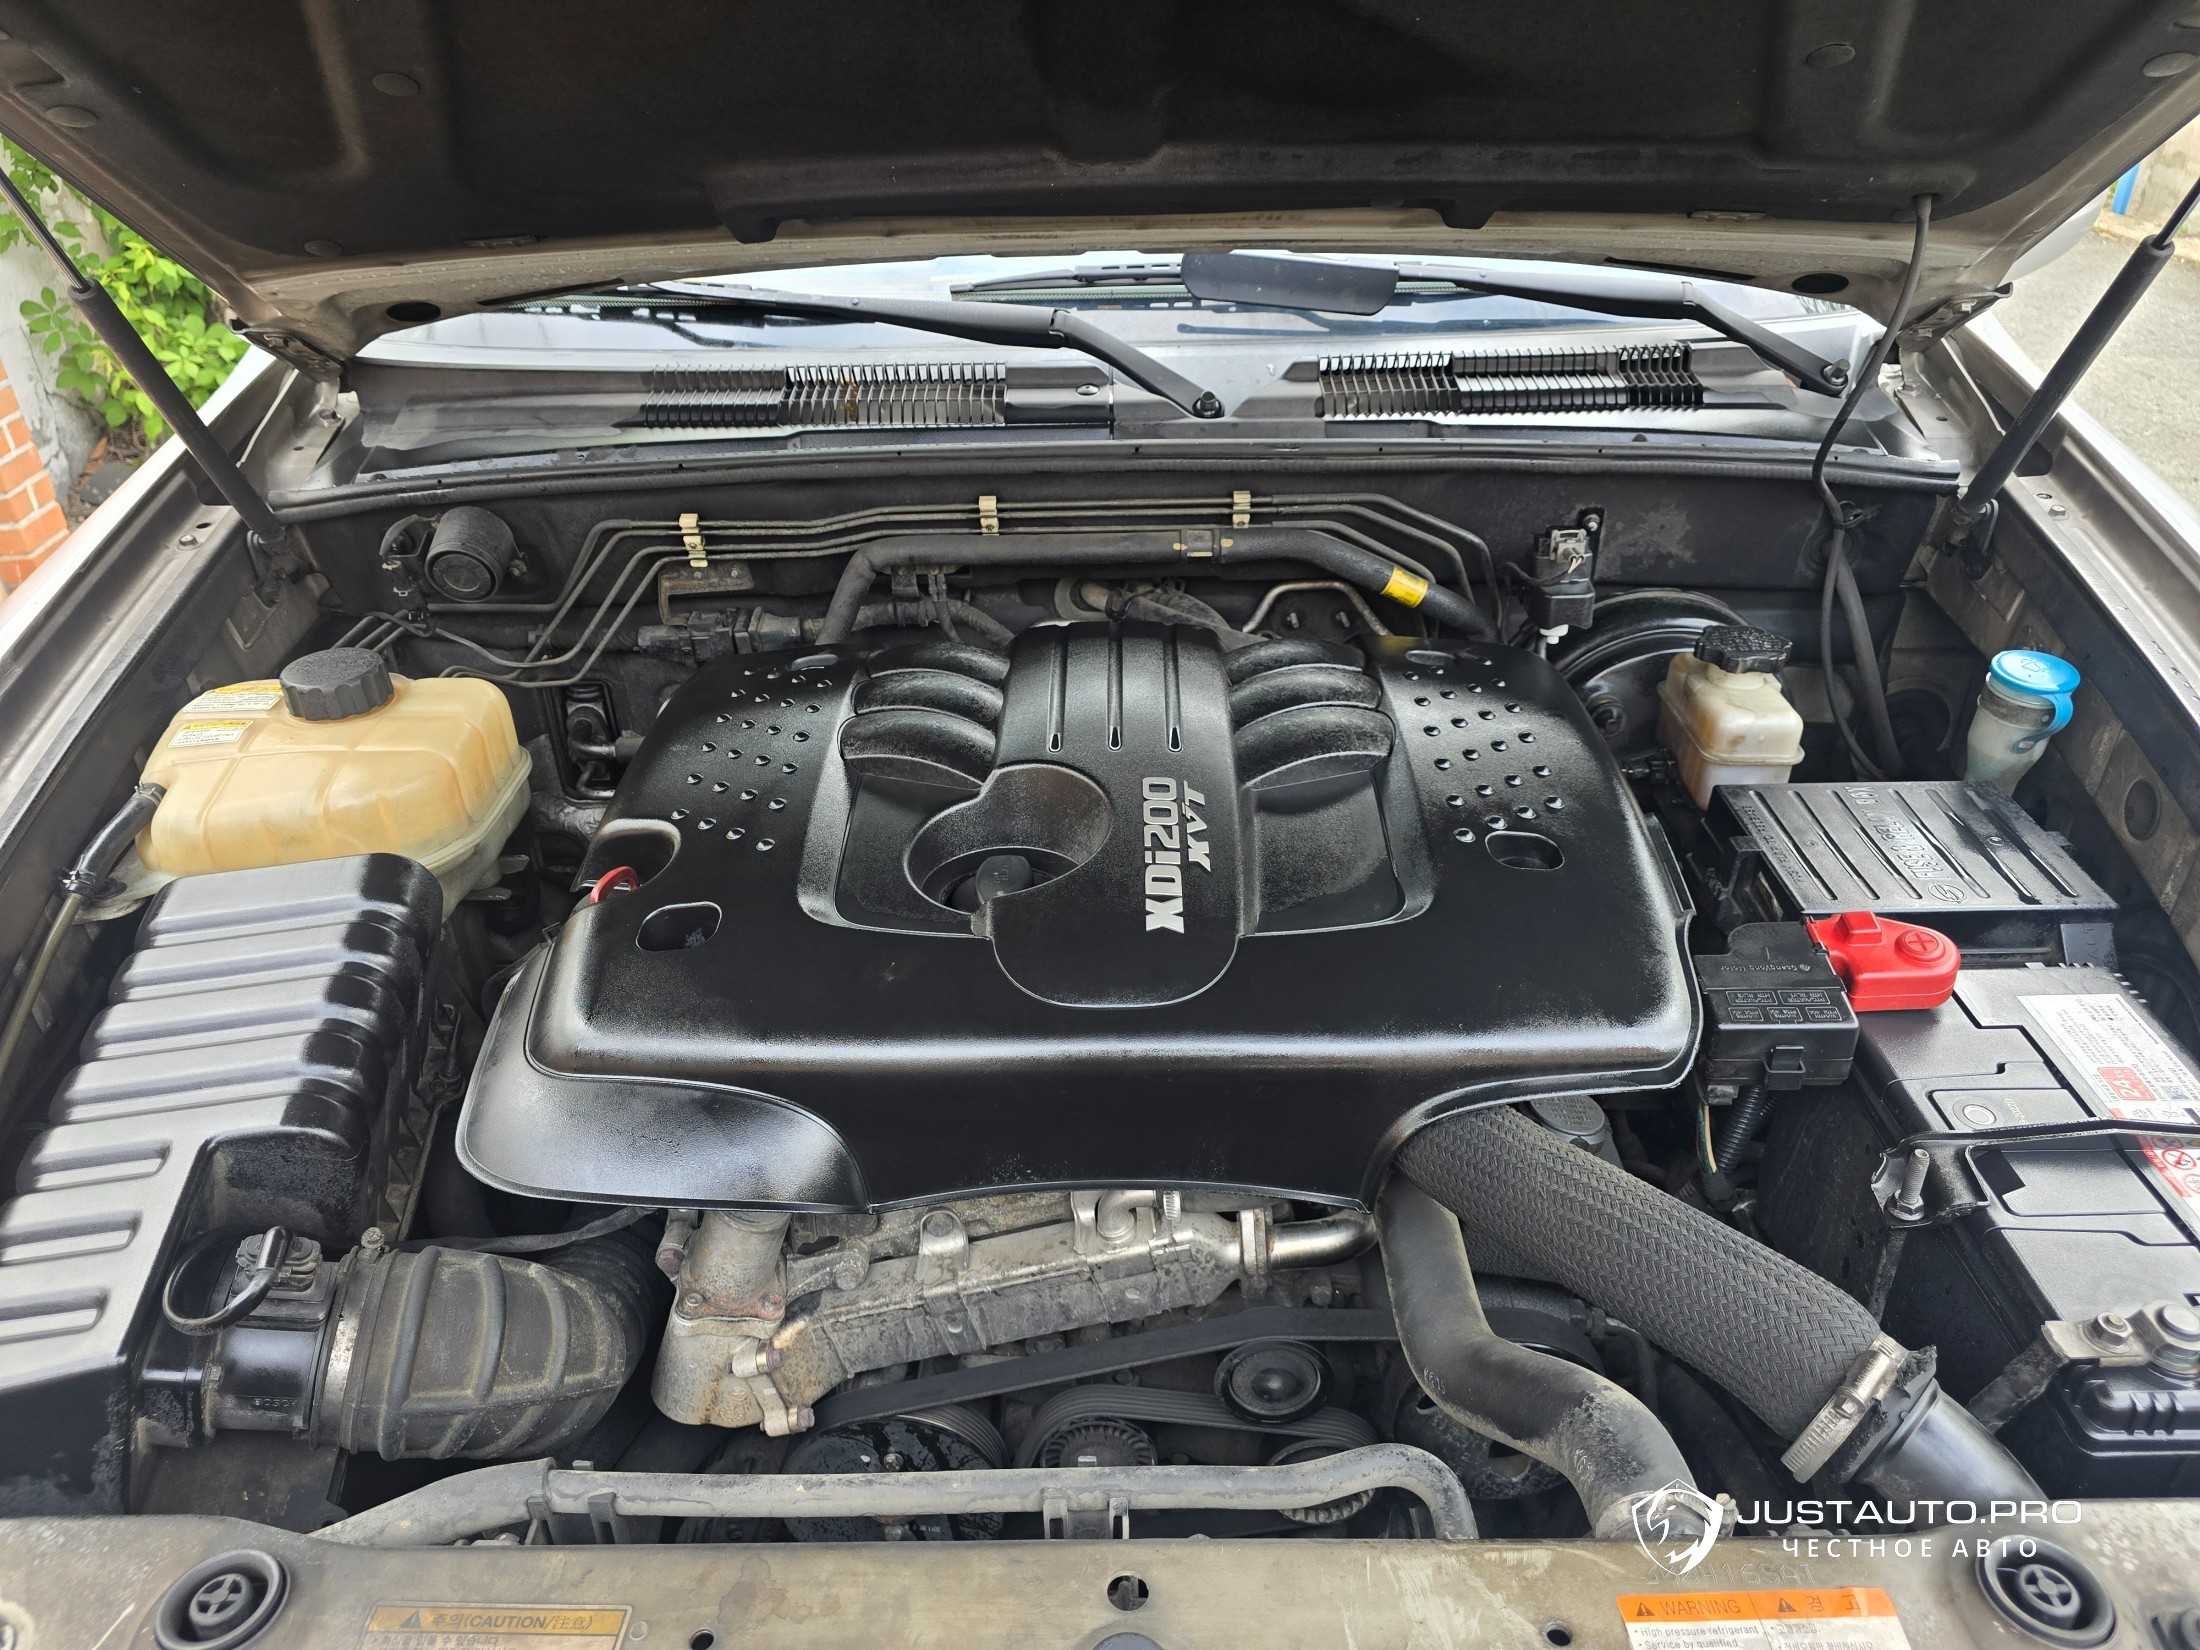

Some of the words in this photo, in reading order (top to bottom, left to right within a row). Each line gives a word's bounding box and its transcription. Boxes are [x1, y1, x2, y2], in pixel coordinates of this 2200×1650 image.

[1142, 776, 1185, 934] XDi200
[1896, 854, 1950, 878] FUSE
[1659, 1599, 1742, 1616] WARNING
[1640, 1627, 1662, 1637] High
[1665, 1628, 1706, 1637] pressure
[1709, 1625, 1759, 1635] refrigerant
[1645, 1640, 1680, 1650] Service
[1684, 1641, 1694, 1650] by
[1697, 1638, 1738, 1649] qualified
